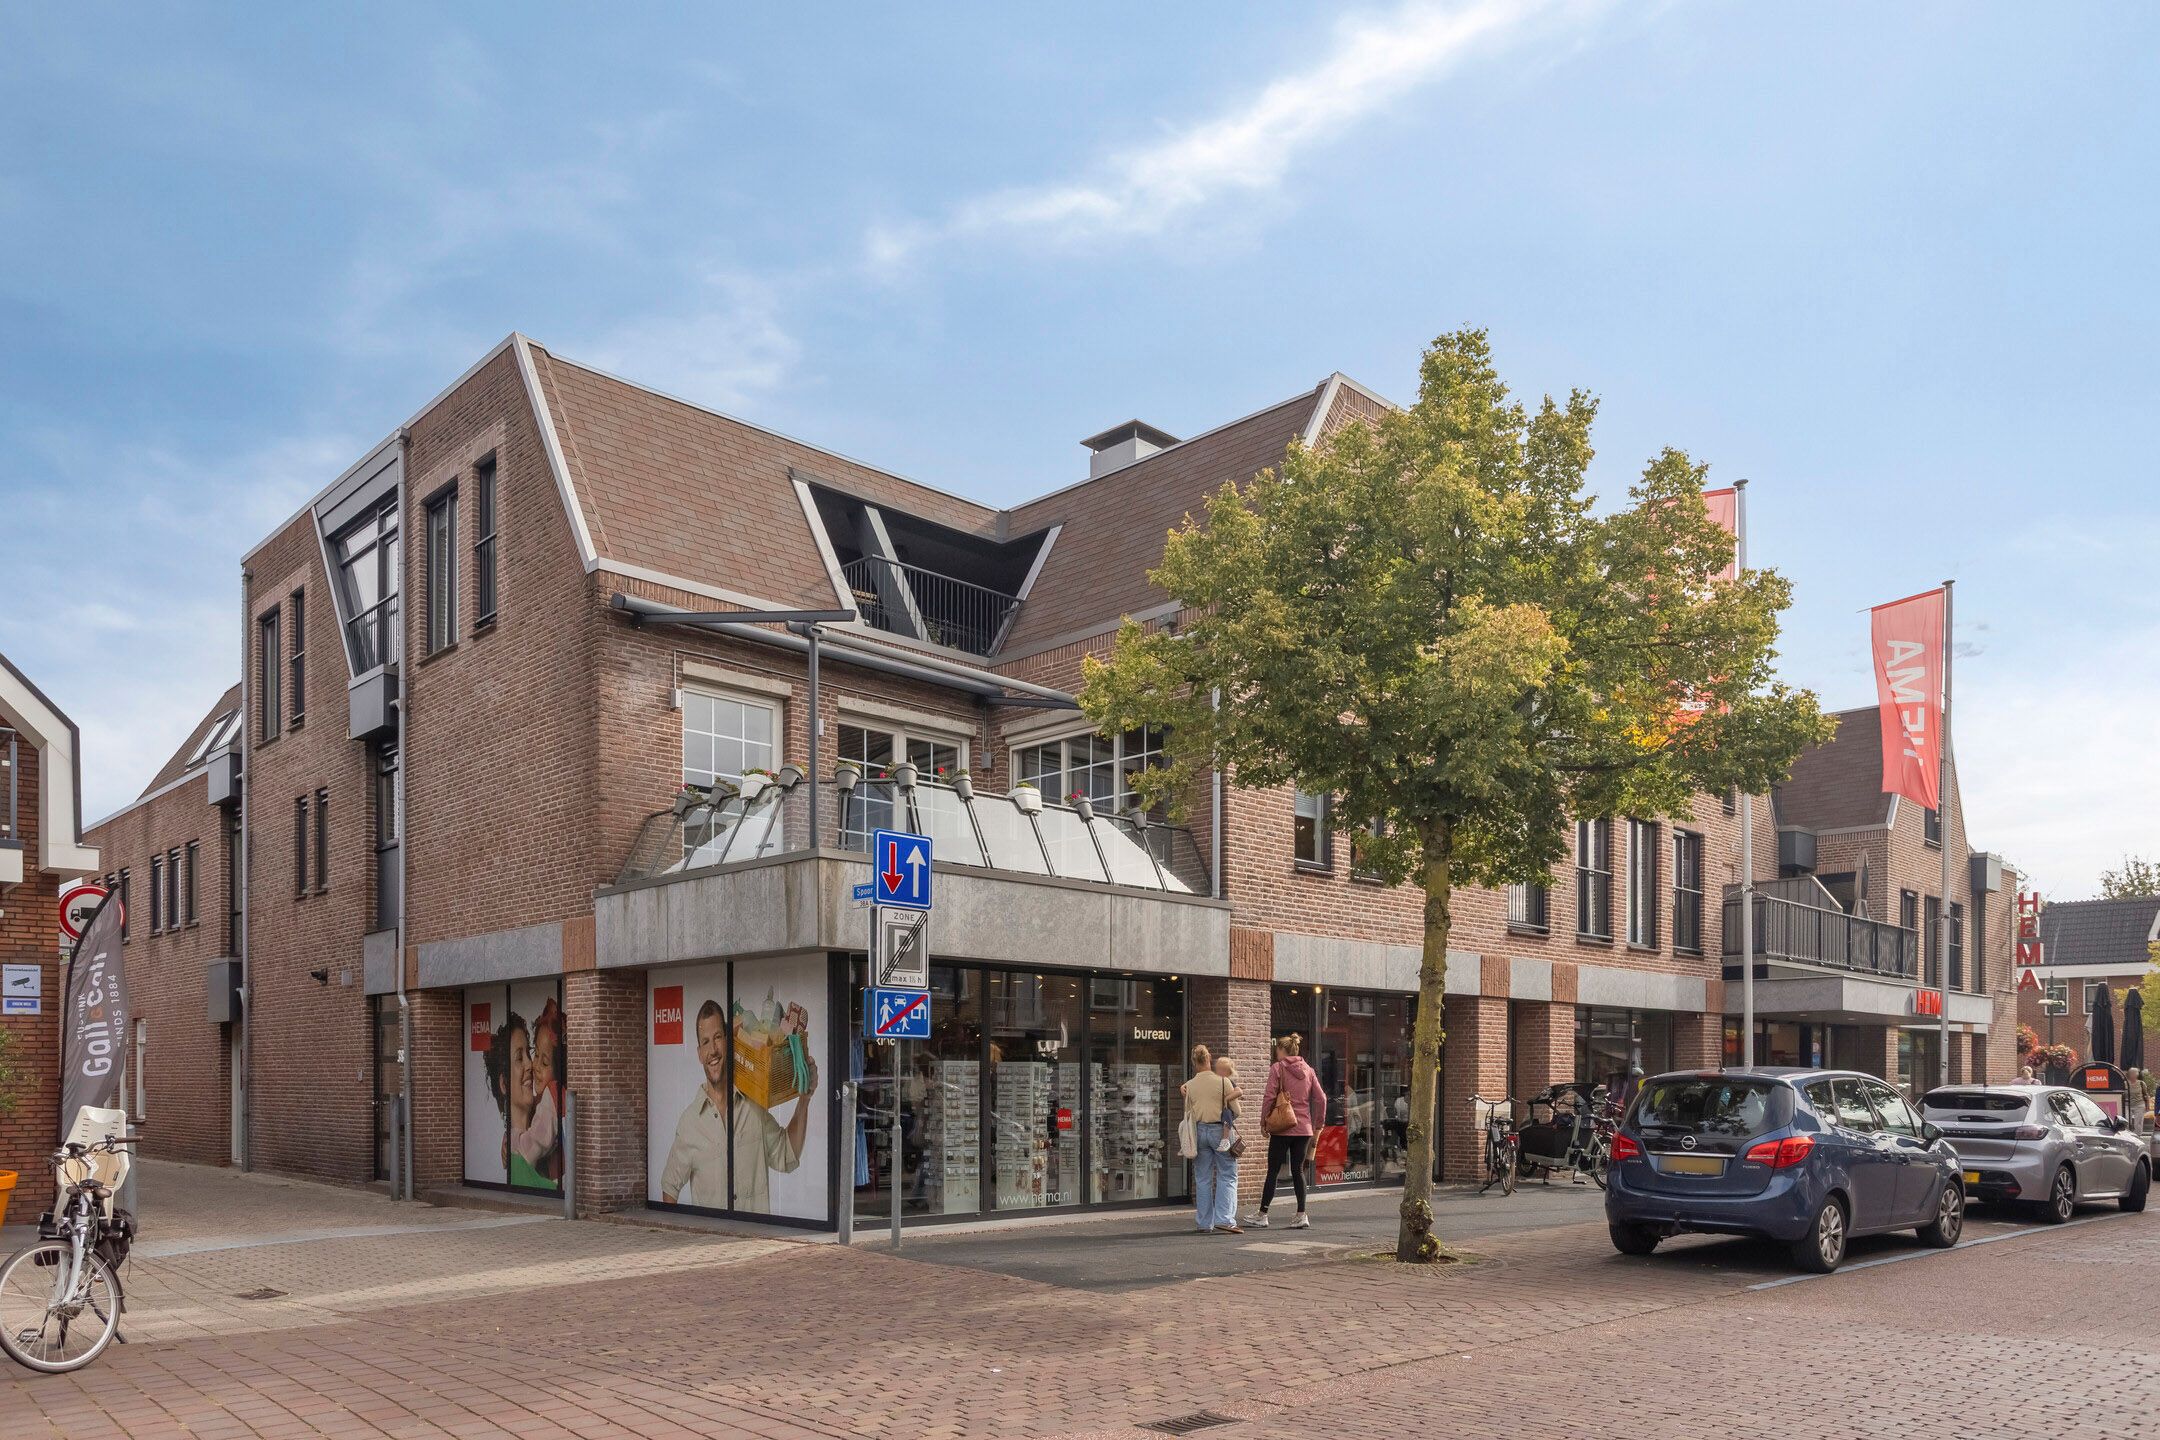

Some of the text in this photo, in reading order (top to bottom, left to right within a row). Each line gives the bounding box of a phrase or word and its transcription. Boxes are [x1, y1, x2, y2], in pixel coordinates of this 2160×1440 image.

[893, 912, 915, 921] ZONE
[2016, 891, 2043, 992] HEMA
[107, 974, 120, 1003] 1884
[1916, 989, 1942, 1015] HEM
[655, 1008, 682, 1023] HEMA
[471, 1021, 490, 1034] HEMA
[1134, 1026, 1171, 1040] bureau
[82, 1021, 112, 1077] Gall
[1320, 1169, 1370, 1181] www.hema.nl
[999, 1189, 1072, 1205] www.hema.nl
